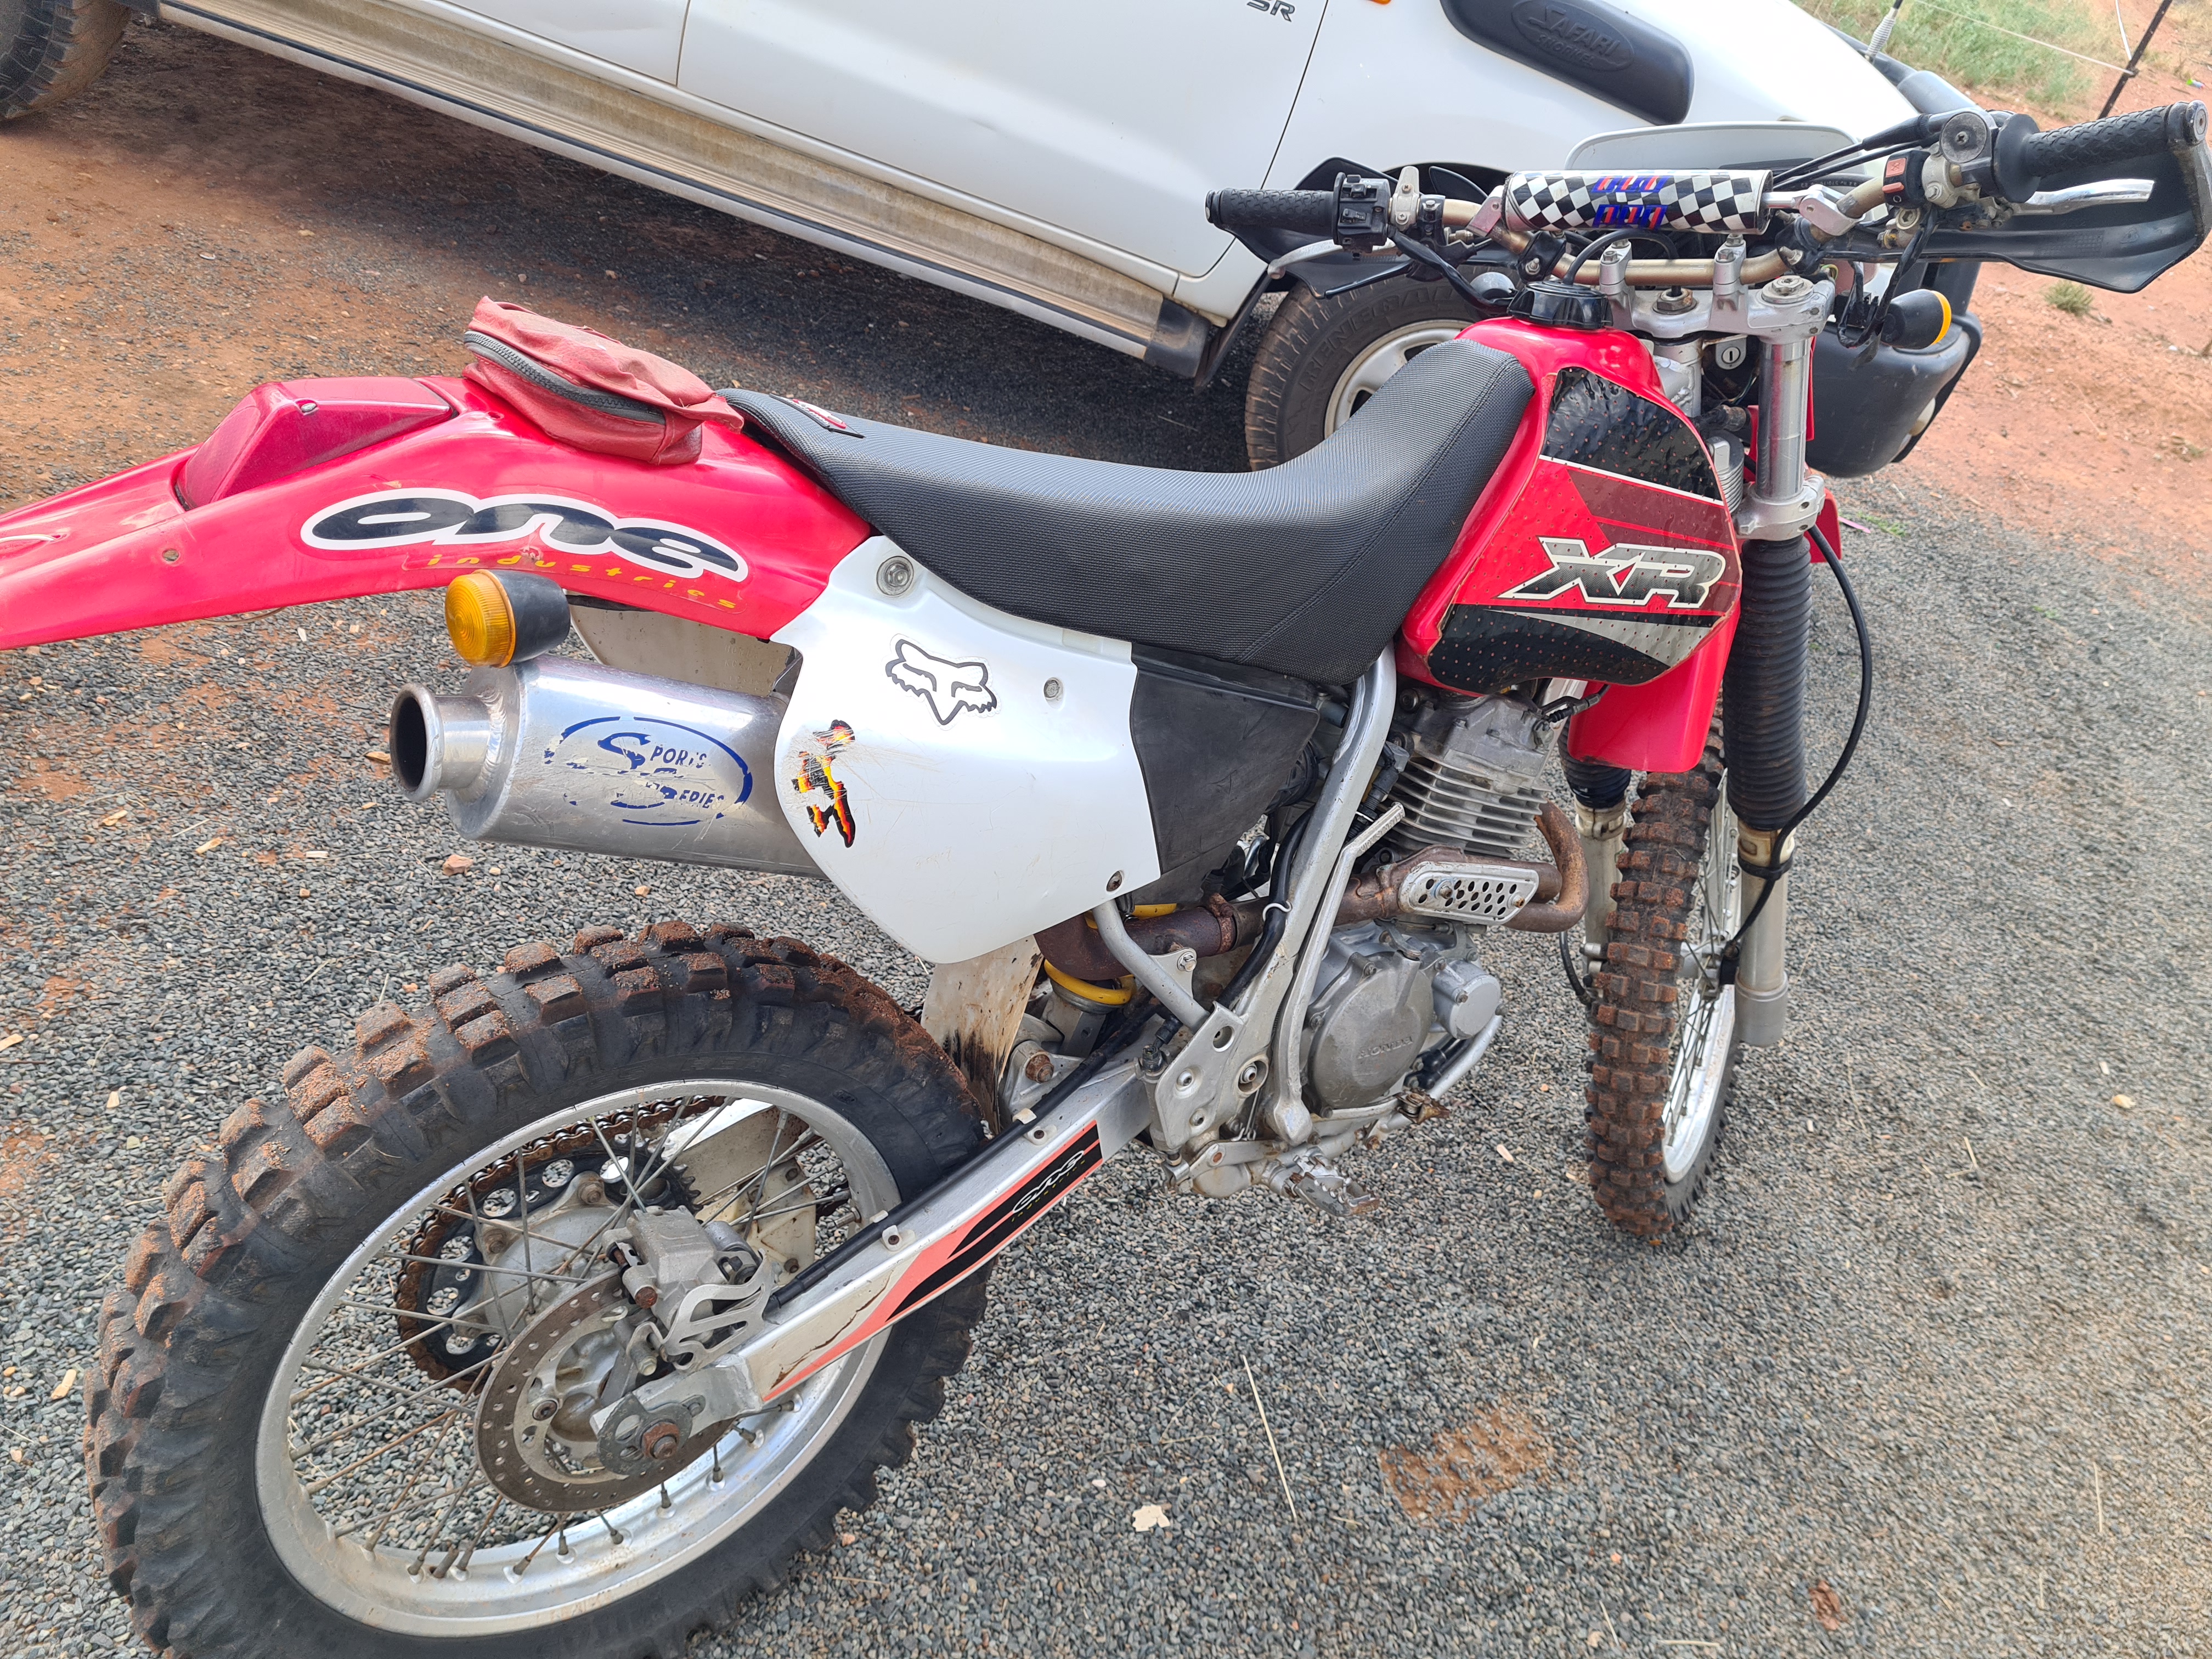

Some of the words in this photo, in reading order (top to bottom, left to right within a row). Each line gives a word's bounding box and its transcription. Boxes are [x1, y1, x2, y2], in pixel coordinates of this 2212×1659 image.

[1246, 0, 1295, 22] SR
[1528, 4, 1621, 56] SAFARI
[427, 553, 737, 610] industries
[1493, 536, 1726, 608] XR
